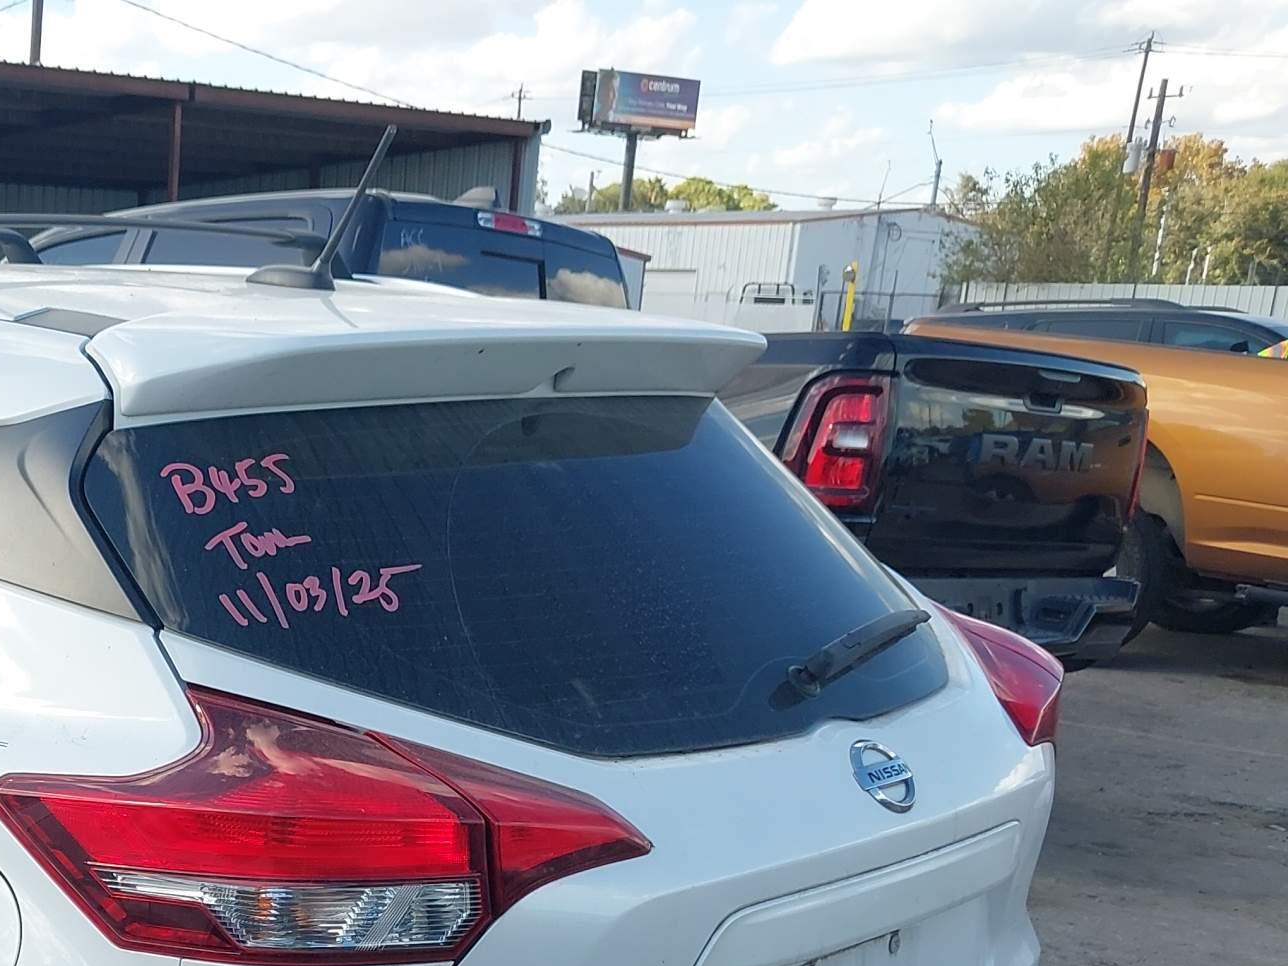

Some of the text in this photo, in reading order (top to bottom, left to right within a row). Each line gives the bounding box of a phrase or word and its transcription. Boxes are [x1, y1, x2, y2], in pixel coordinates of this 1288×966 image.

[160, 453, 295, 515] B455
[980, 433, 1094, 473] RAM
[218, 563, 423, 629] 11/03/25
